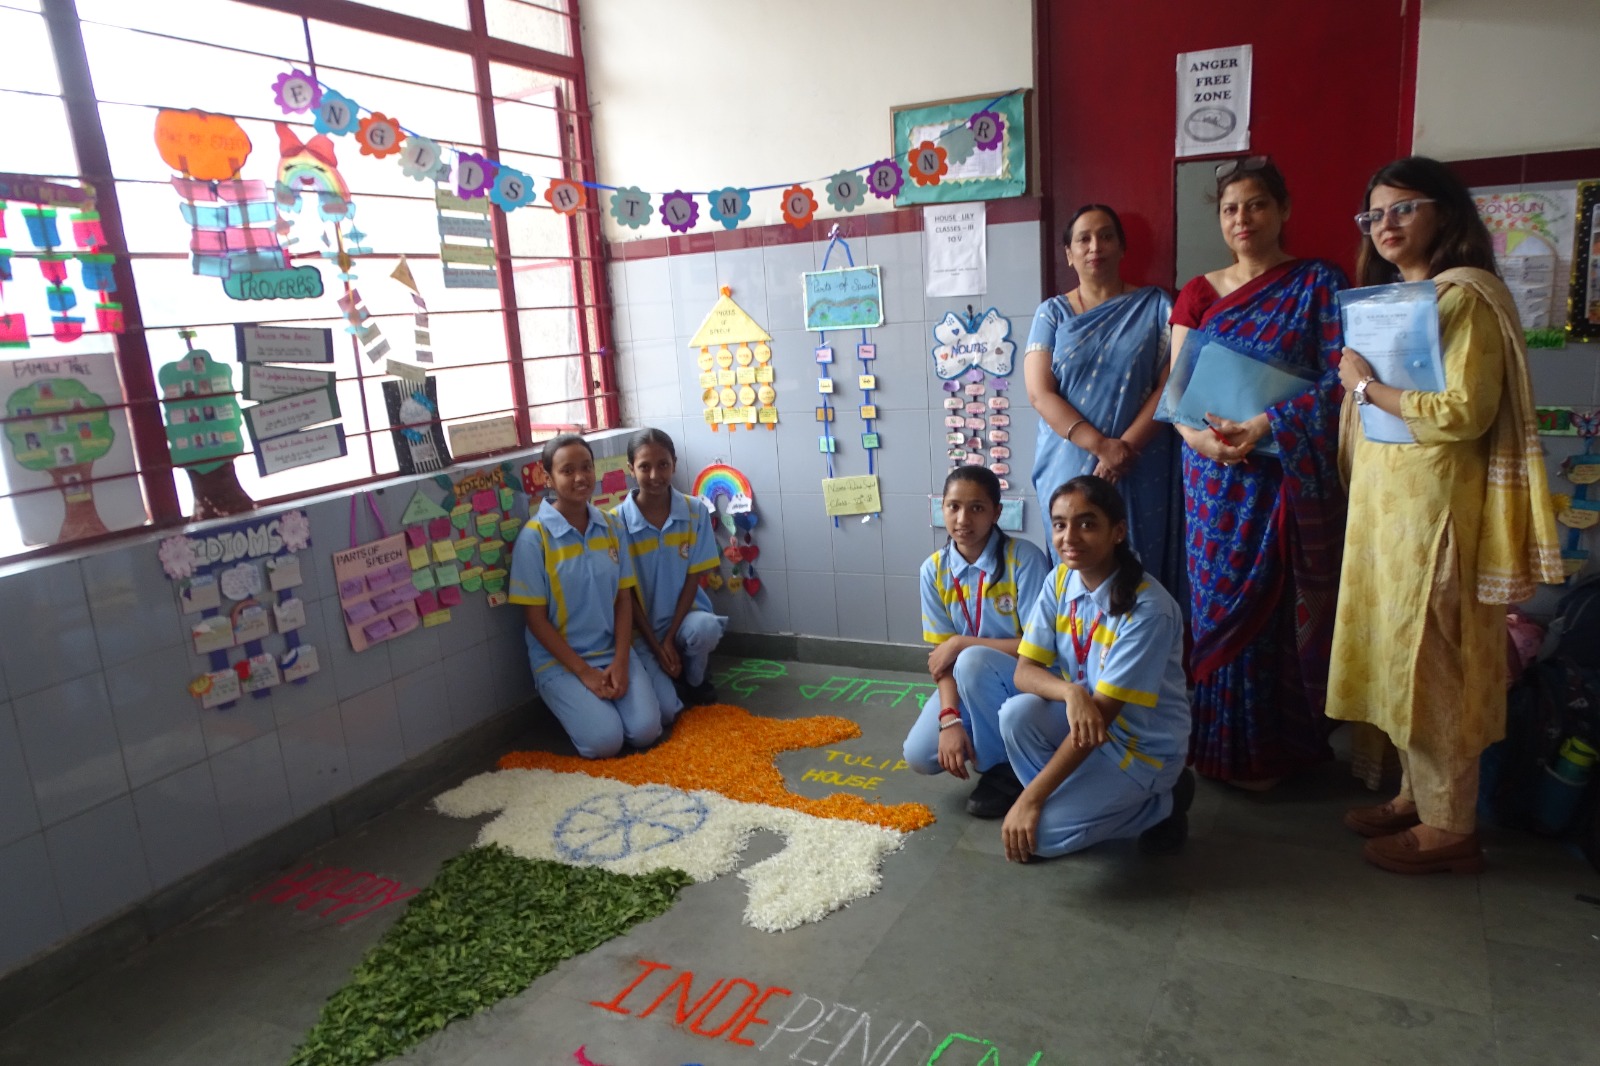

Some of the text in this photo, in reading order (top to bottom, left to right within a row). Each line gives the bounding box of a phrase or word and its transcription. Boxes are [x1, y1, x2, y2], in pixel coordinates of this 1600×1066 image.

[1189, 58, 1239, 72] ANGER
[1195, 75, 1232, 87] FREE
[1193, 90, 1232, 103] ZONE
[1475, 202, 1545, 214] RONOUN
[934, 214, 957, 222] HOUSE
[935, 225, 961, 233] CLASSES
[239, 272, 316, 298] PROVERBS
[458, 472, 502, 497] IDIOMS
[188, 520, 283, 566] IDIOMS
[336, 550, 367, 565] PARTS
[365, 549, 403, 568] SPEECH
[825, 749, 910, 772] TULIP
[801, 768, 886, 791] HOUSE
